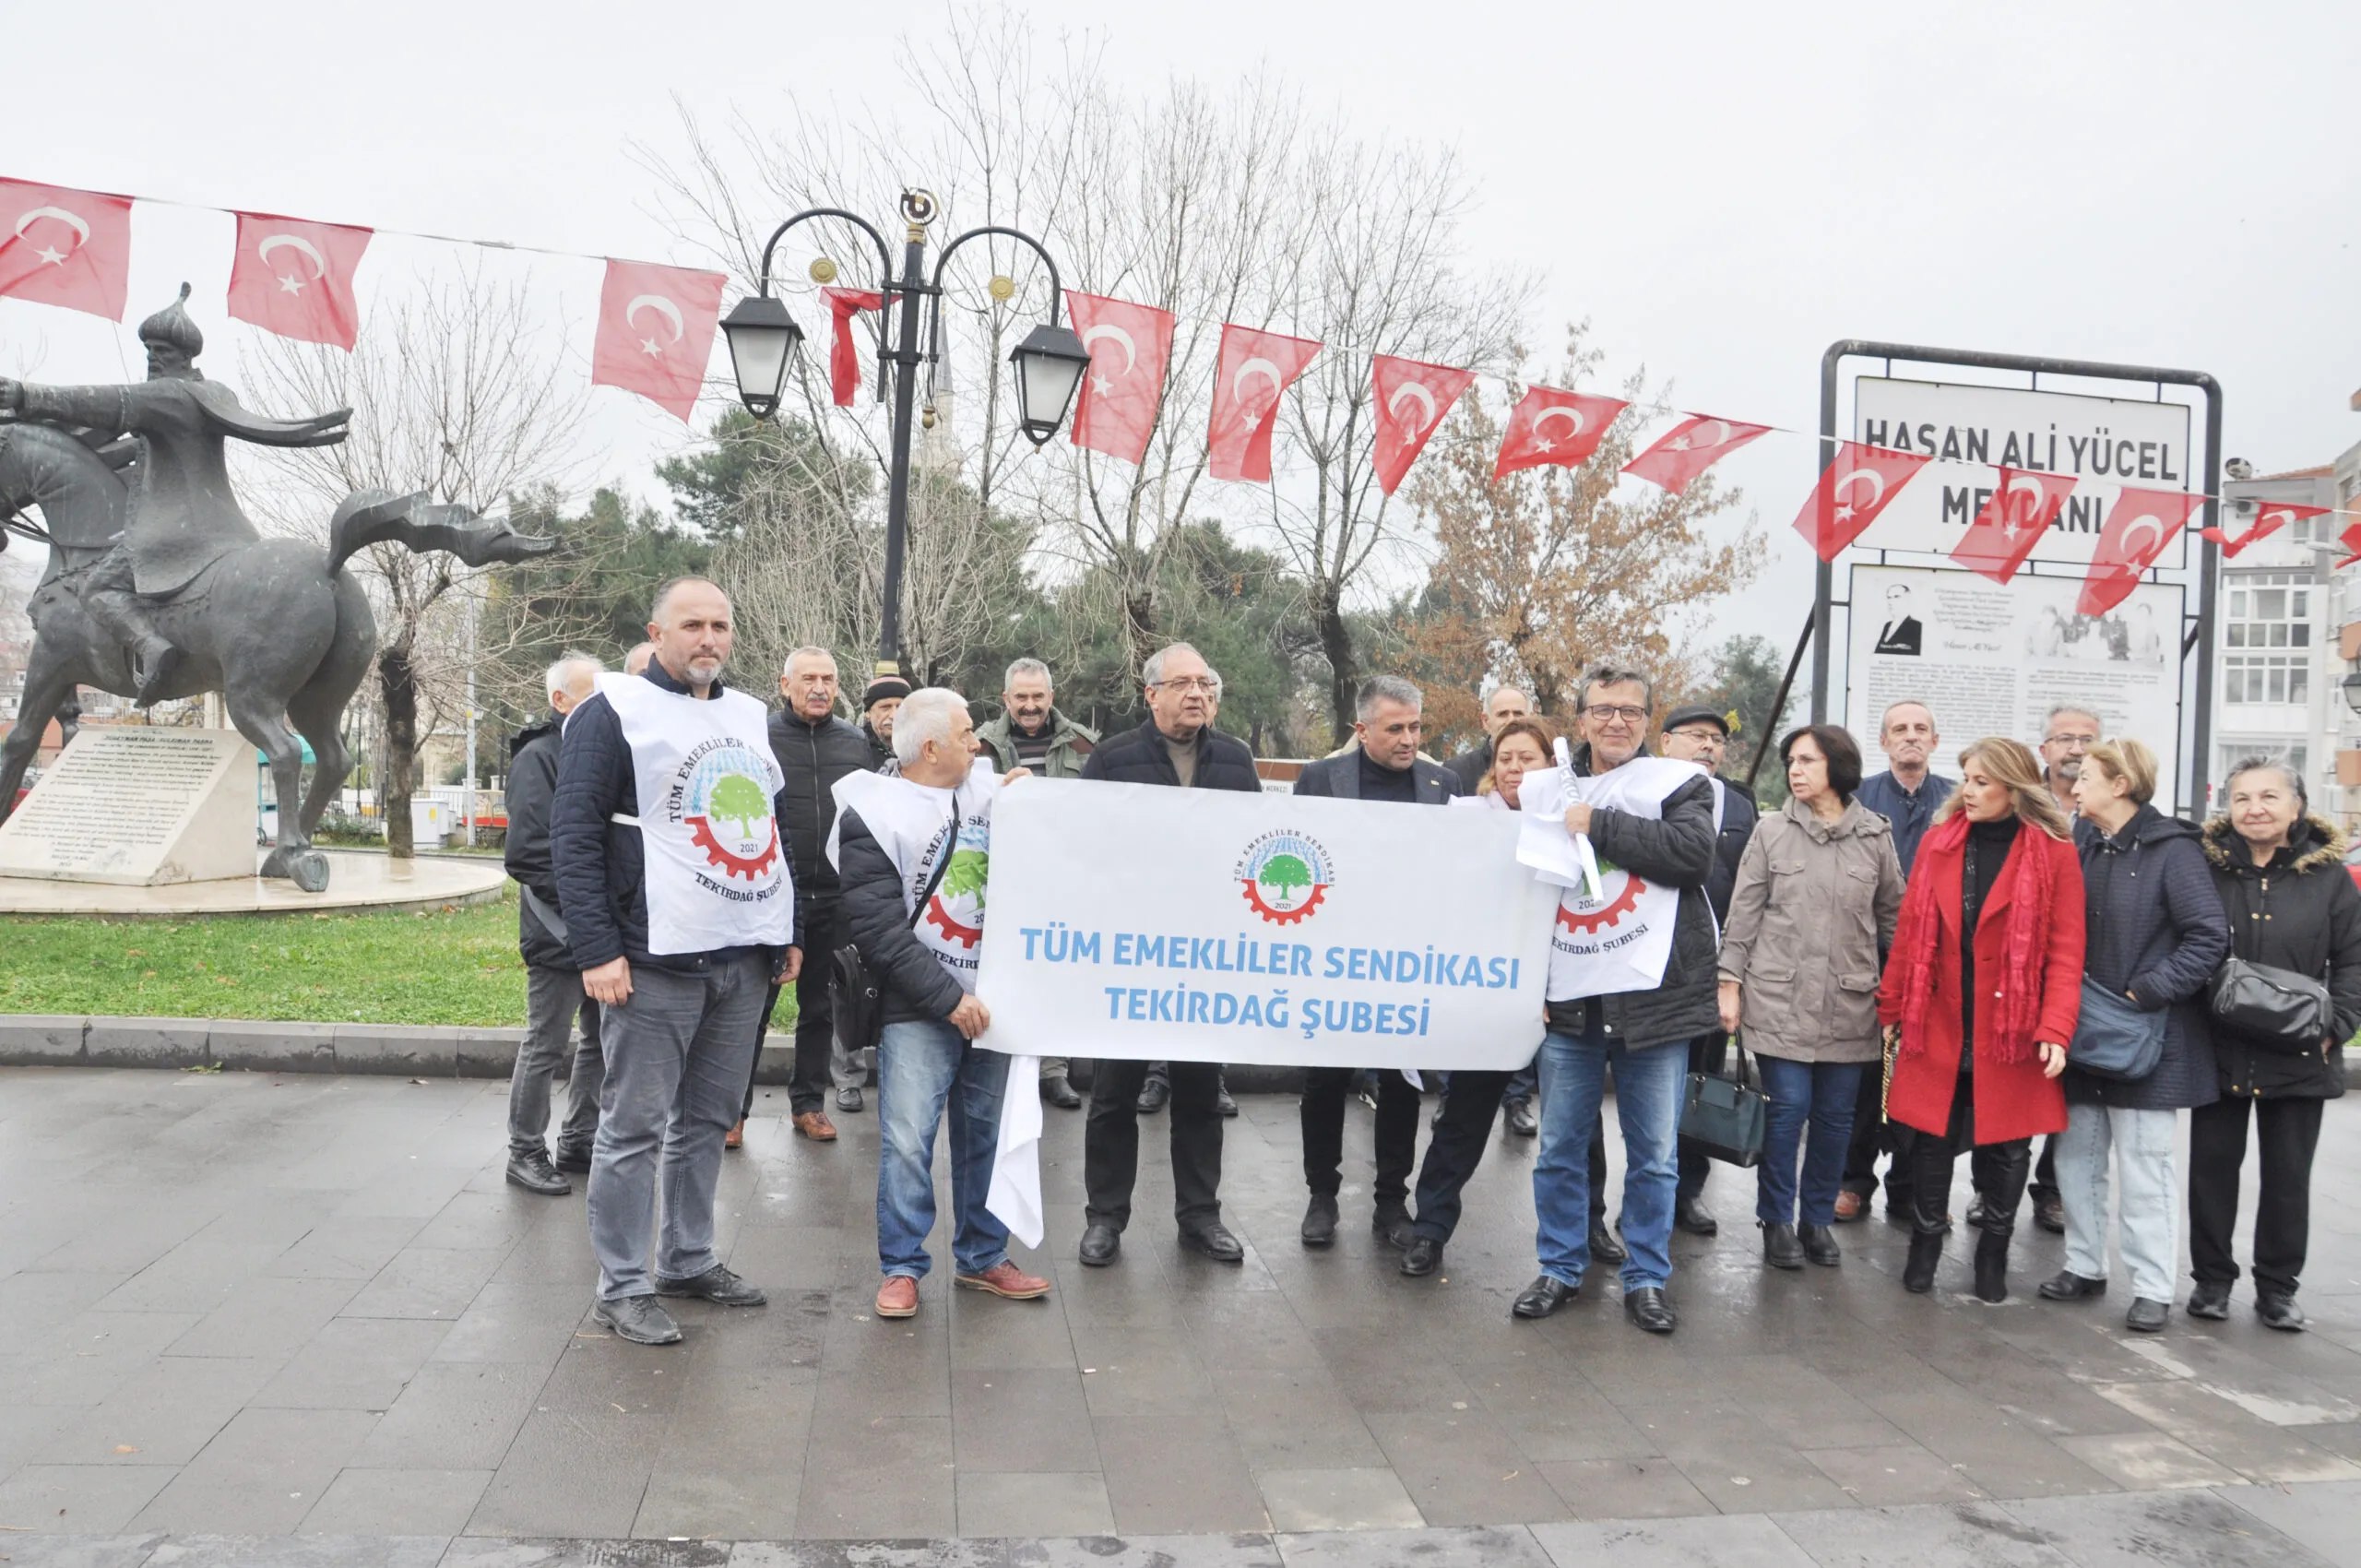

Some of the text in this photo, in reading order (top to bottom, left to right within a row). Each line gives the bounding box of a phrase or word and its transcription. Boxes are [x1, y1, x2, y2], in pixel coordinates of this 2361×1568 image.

[1866, 419, 2178, 481] HASAN ALİ YÜCEL
[1942, 485, 2103, 534] MEYDANI
[669, 735, 746, 823] TÜM EMEKLİLER
[740, 843, 759, 854] 2021
[1242, 828, 1301, 857] EMEKLİLER
[695, 872, 754, 902] TEKİRDAĞ
[1578, 898, 1595, 909] 202
[1275, 902, 1291, 910] 2021
[1019, 921, 1520, 990] TÜM EMEKLİLER SENDİKASI
[1552, 921, 1650, 956] EKİRDAĞ ŞUBESİ
[1104, 982, 1431, 1039] TEKİRDAĞ ŞUBESİ
